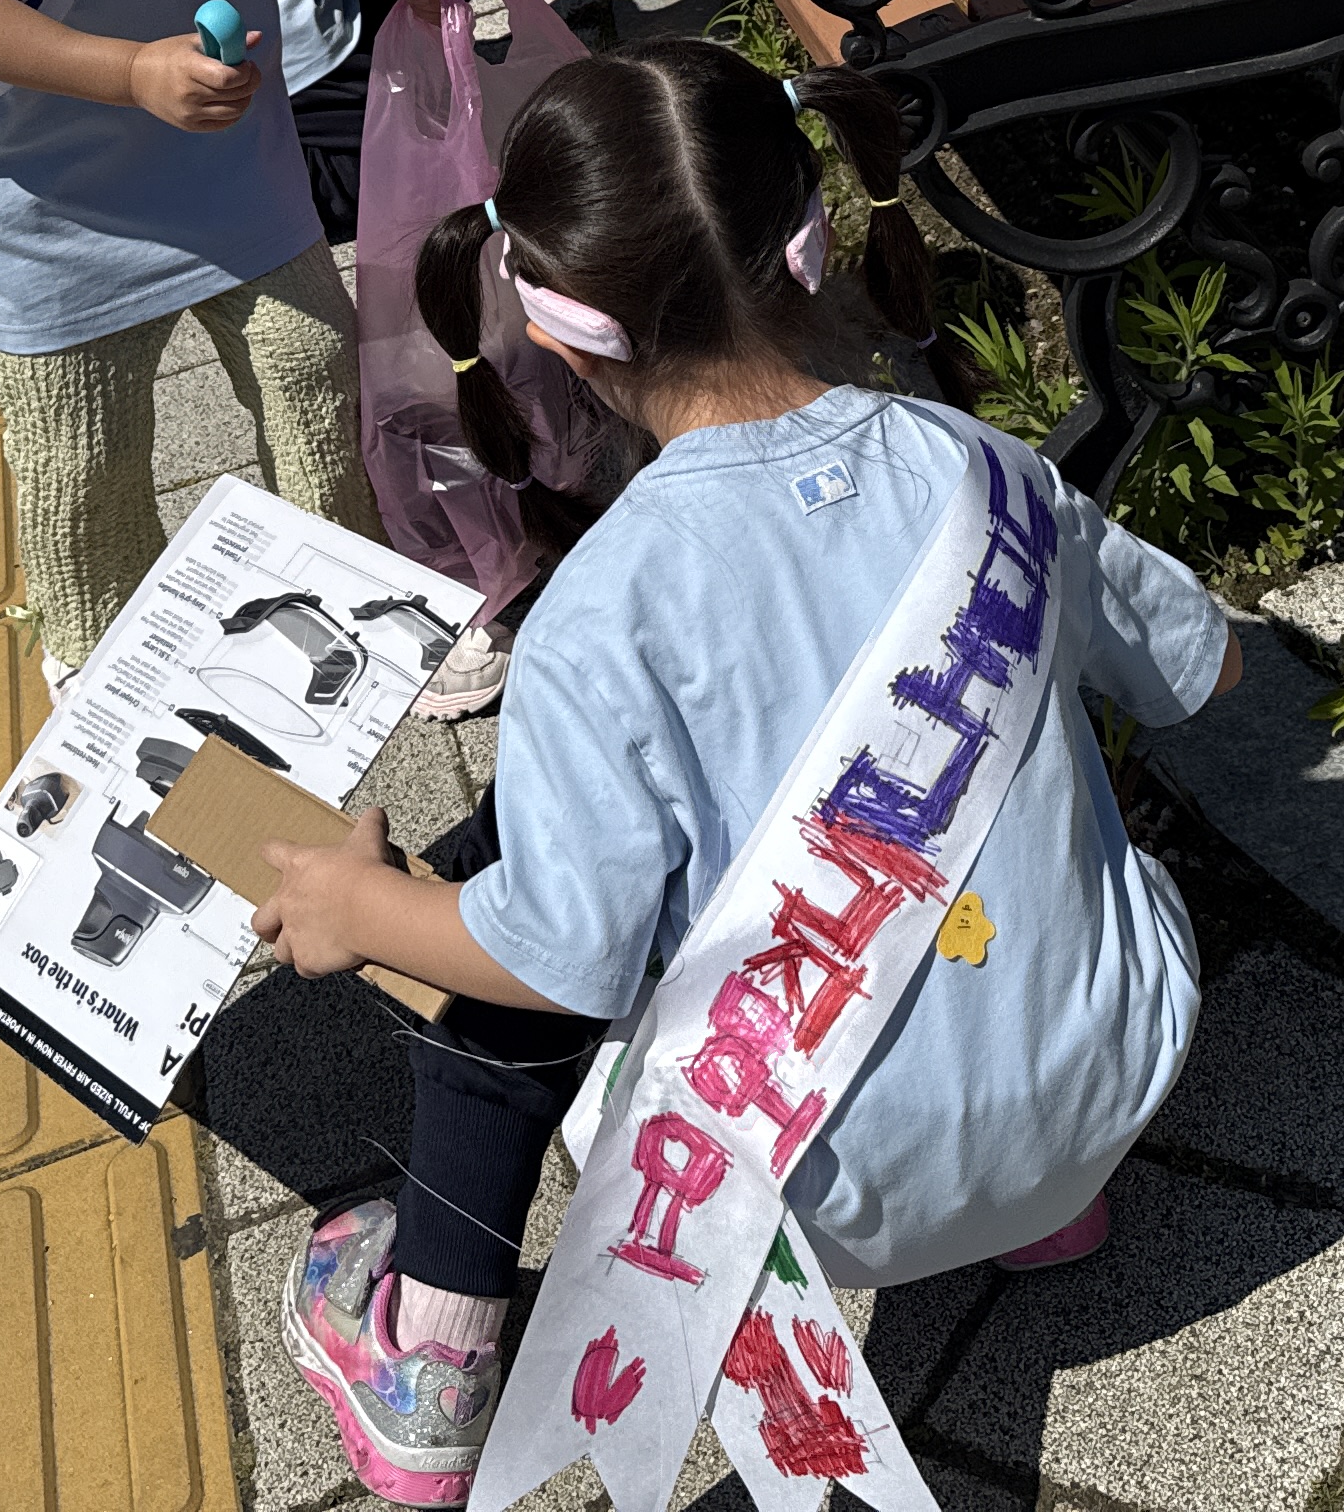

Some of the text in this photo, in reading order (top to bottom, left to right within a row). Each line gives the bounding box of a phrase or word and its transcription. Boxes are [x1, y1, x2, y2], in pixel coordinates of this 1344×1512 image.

[103, 681, 141, 707] Crisper plate
[345, 758, 366, 775] esign
[16, 941, 142, 1041] What's in the box
[17, 1025, 28, 1037] A
[25, 1030, 37, 1044] IN
[33, 1037, 55, 1058] NOW
[51, 1051, 79, 1076] FRYER
[75, 1069, 92, 1086] AIR
[88, 1079, 115, 1104] SIZED
[111, 1096, 134, 1119] FULL
[130, 1111, 142, 1125] A
